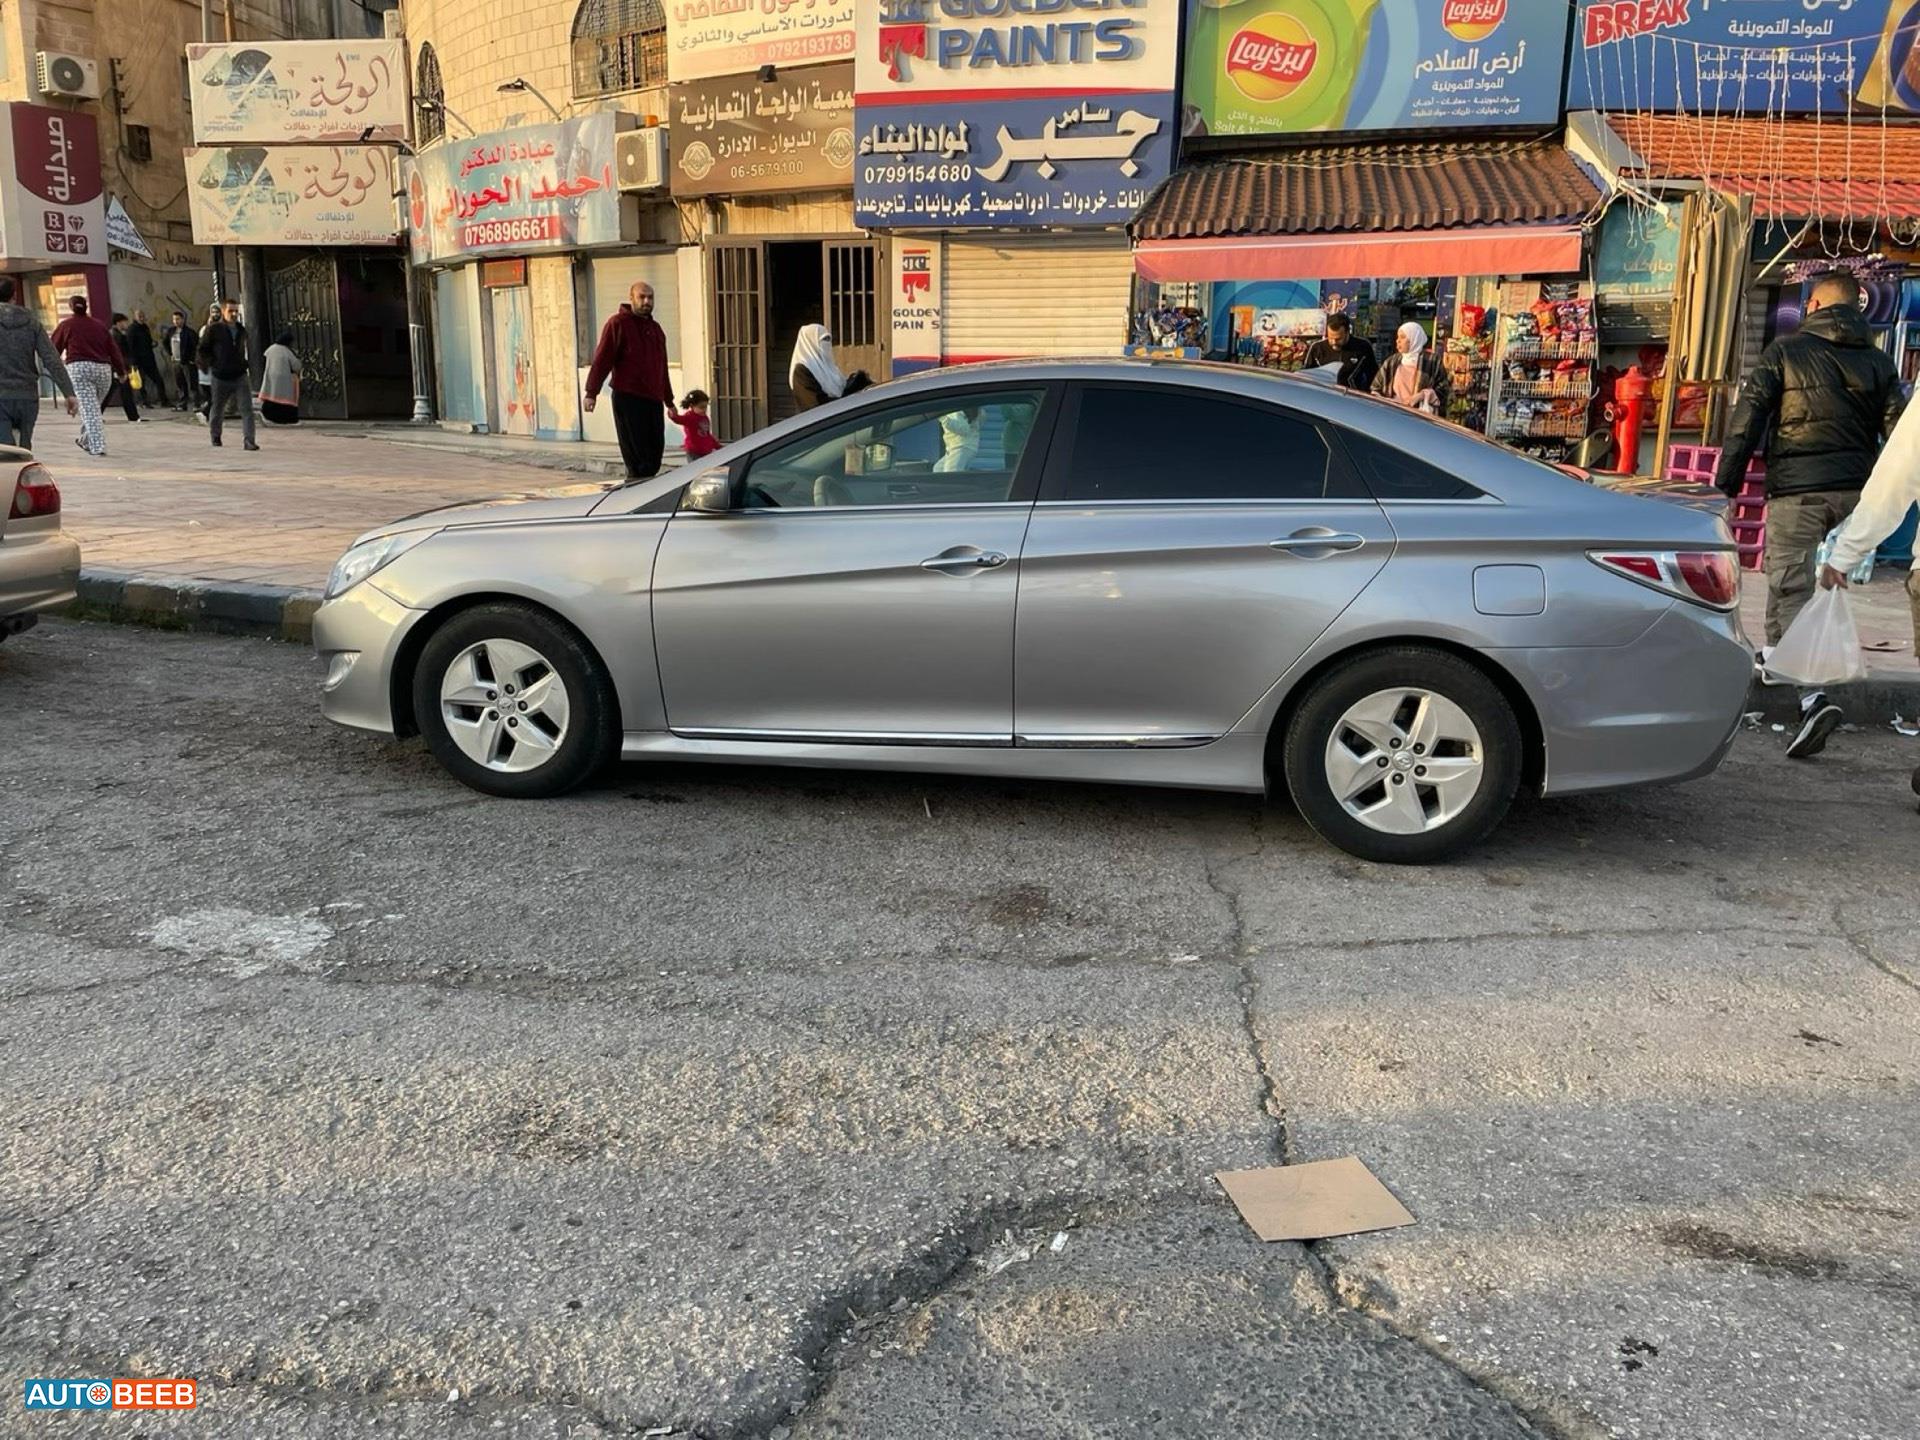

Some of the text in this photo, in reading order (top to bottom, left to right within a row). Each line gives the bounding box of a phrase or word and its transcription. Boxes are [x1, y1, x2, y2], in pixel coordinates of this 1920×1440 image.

[800, 9, 853, 30] لدورات
[1447, 0, 1484, 21] Lay's
[1584, 0, 1690, 48] BREAK
[677, 30, 734, 51] والثانوي
[1728, 19, 1833, 38] للمواد التموينية
[768, 35, 850, 58] 0792193738
[938, 18, 1137, 69] PAINTS
[1232, 37, 1285, 71] Lay's
[1271, 46, 1312, 75] ليز
[1415, 40, 1526, 78] أرض السلام
[1432, 78, 1504, 92] للمواد التموينية
[680, 80, 855, 131] معية الولجة التعاونية
[1056, 100, 1111, 129] سامر
[770, 130, 816, 154] الديوان
[858, 110, 1161, 182] جبر لمواد البناء
[45, 116, 76, 201] صيدلية
[460, 138, 555, 177] عيادة الدكتور
[731, 161, 804, 179] 06-5679100
[864, 164, 972, 184] 0799154680
[434, 163, 612, 226] احمد الحوراني
[914, 191, 972, 219] كهربائيات
[982, 191, 1014, 217] صحية
[1014, 191, 1050, 216] ادوات
[1063, 189, 1108, 215] خردوات
[464, 218, 551, 246] 0796896661
